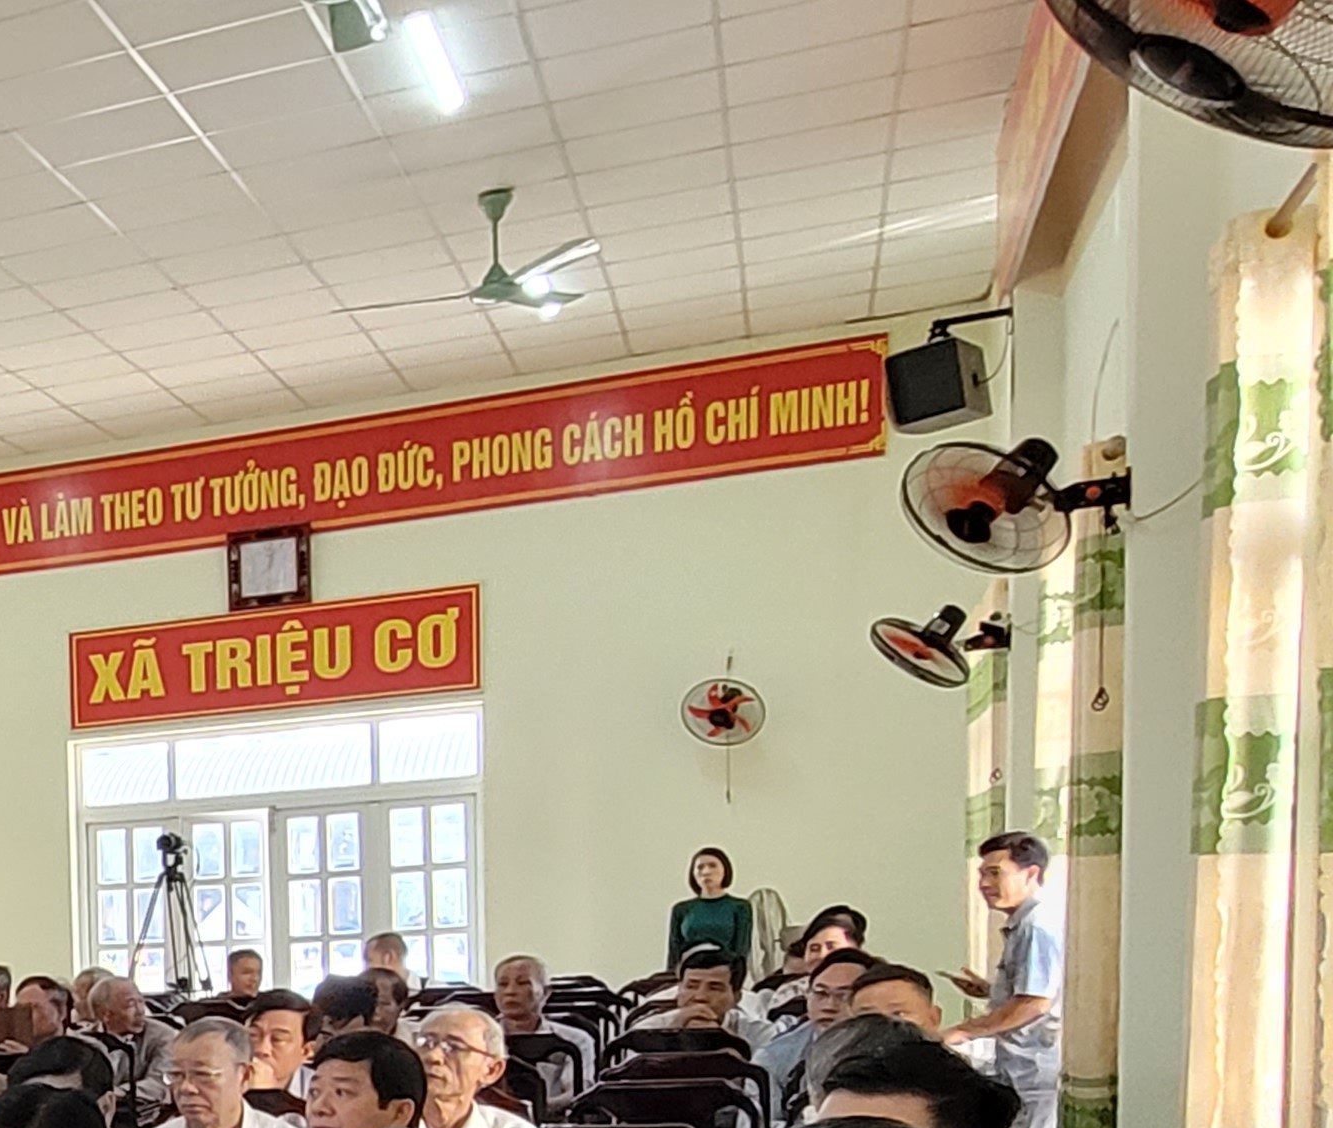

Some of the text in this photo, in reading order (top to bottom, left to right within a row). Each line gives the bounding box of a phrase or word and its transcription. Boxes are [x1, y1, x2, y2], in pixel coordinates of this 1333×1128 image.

[2, 498, 34, 545] VÀ
[100, 487, 163, 532] THEO
[170, 476, 205, 523] TƯ
[209, 459, 305, 517] TƯỞNG,
[313, 456, 369, 509] ĐẠO
[377, 440, 443, 491] ĐỨC,
[452, 427, 553, 483] PHONG
[562, 411, 644, 466] CÁCH
[653, 391, 695, 453] HỒ
[705, 386, 761, 445] CHÍ
[769, 378, 870, 436] MINH!
[88, 606, 460, 705] XÃ TRIỆU CƠ
